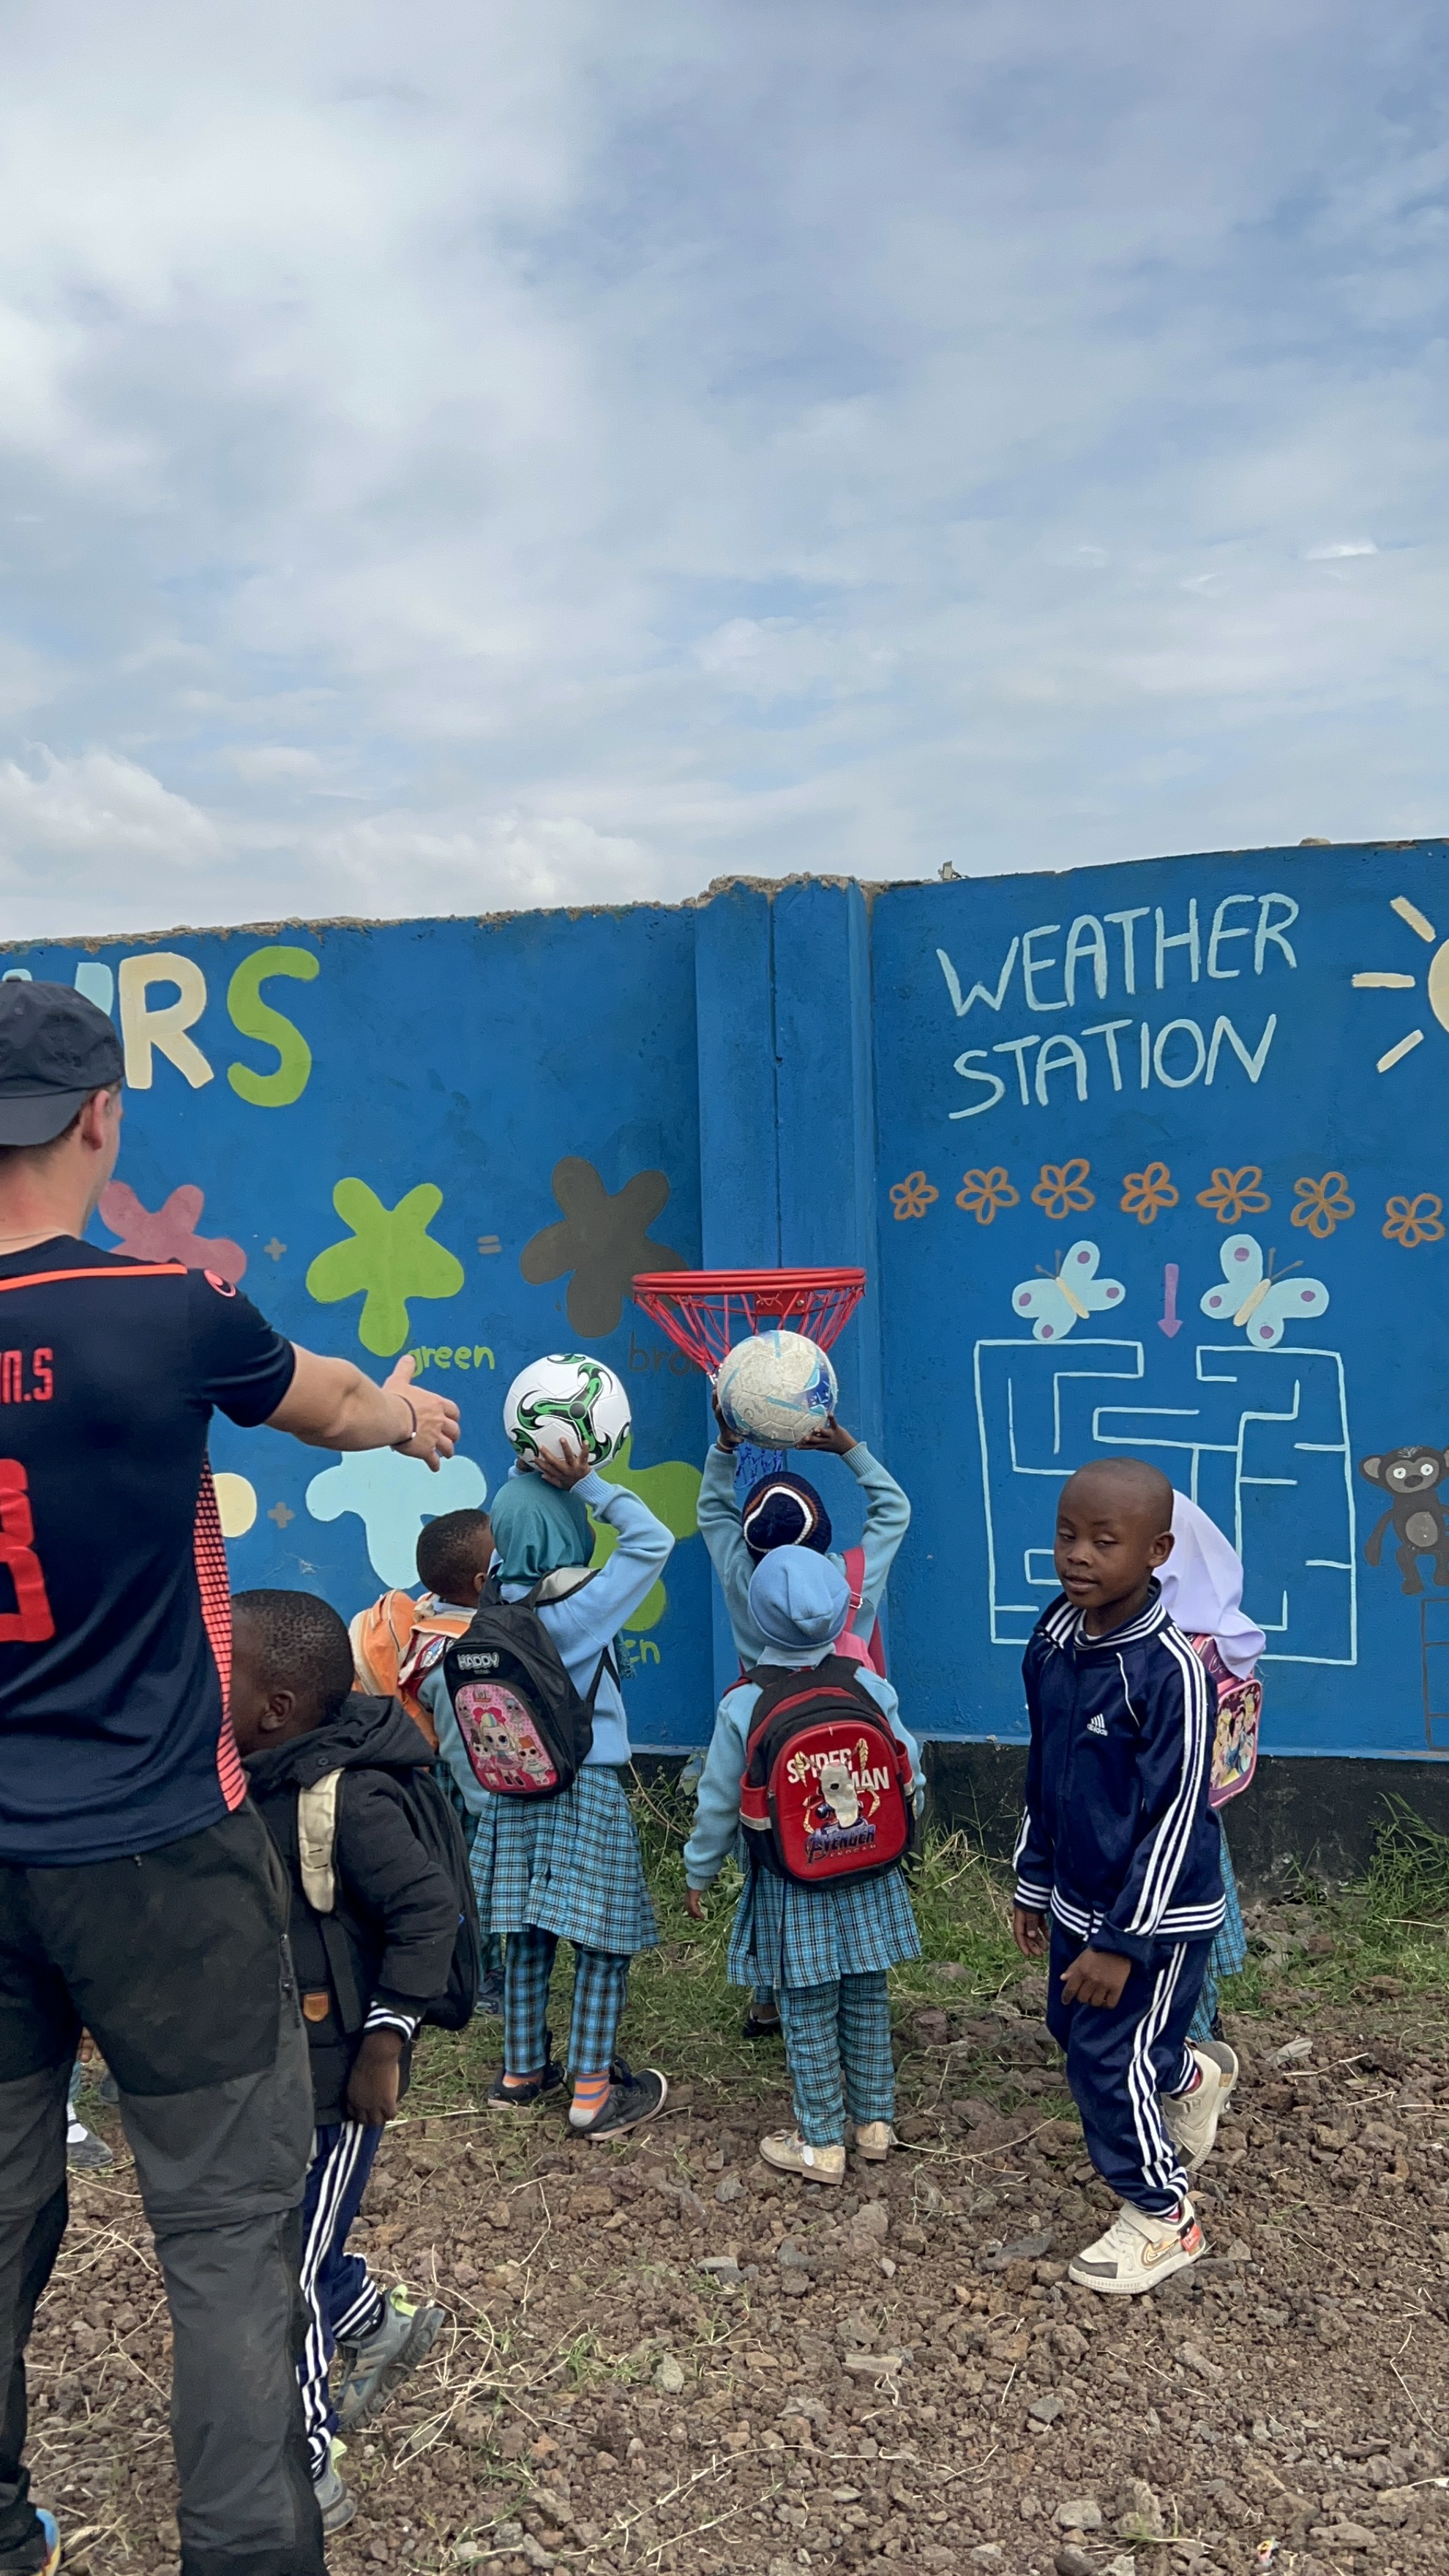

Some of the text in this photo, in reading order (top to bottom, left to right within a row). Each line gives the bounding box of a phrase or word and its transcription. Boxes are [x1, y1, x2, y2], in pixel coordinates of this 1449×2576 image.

[937, 893, 1299, 1016] WEATHER
[2, 946, 320, 1107] RS
[948, 1014, 1276, 1119] STATION
[629, 1329, 703, 1376] bro
